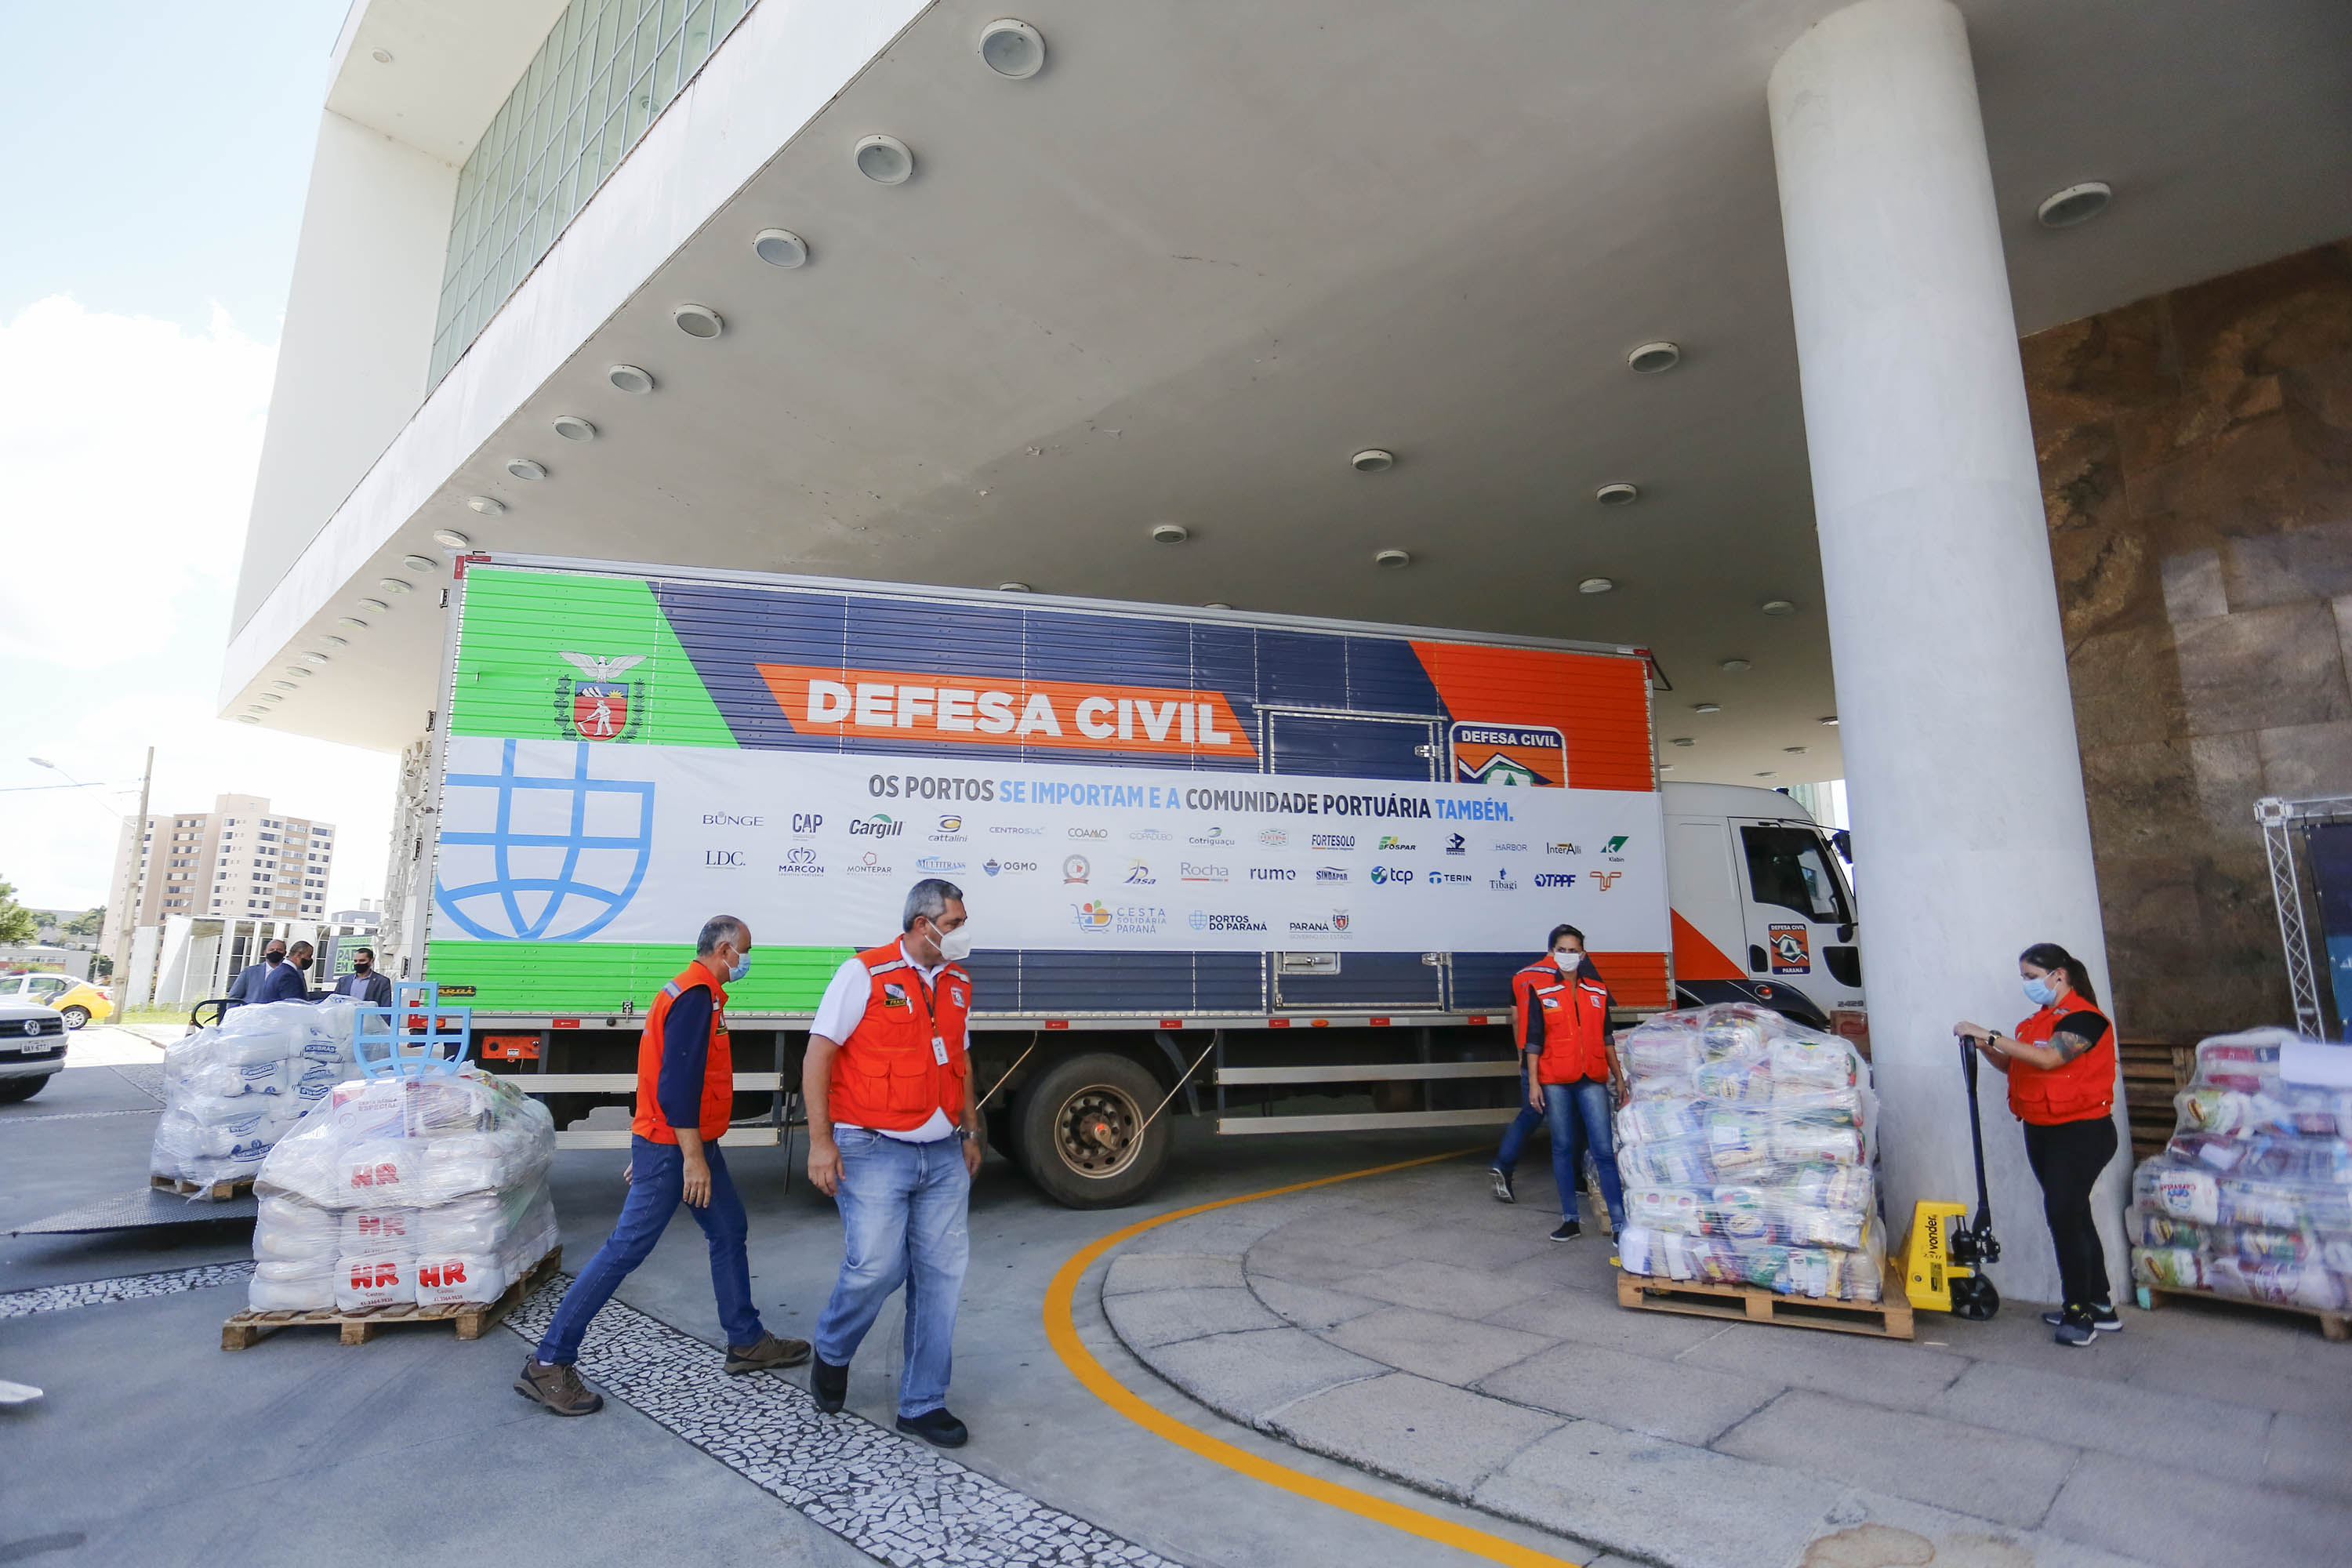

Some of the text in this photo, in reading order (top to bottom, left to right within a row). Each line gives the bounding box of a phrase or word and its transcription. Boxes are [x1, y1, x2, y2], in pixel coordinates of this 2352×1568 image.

[807, 679, 1231, 744] DEFESA CIVIL
[1461, 730, 1559, 747] DEFESA CIVIL
[869, 774, 1514, 822] OS PORTOS SE IMPORTAM E A COMUNIDADE PORTUÁRIA TAMBÉM.
[702, 814, 765, 826] BUNGE
[793, 813, 823, 833] CAP
[849, 819, 903, 839] Cargill
[1068, 828, 1108, 839] COAMO
[927, 834, 967, 843] cattalini
[1189, 837, 1235, 846] Cotriguaçu
[1312, 834, 1356, 847] FORTESOLO
[1004, 862, 1037, 871] OGMO
[1180, 862, 1229, 877] Rocha
[1250, 868, 1296, 880] rumo
[1316, 870, 1348, 880] SINDAPAR
[1391, 867, 1414, 884] tcp
[1490, 880, 1518, 891] Tibagi
[1116, 907, 1166, 916] CESTA
[1227, 921, 1268, 931] PARANÁ
[1290, 920, 1330, 931] PARANÁ
[351, 1163, 400, 1189] HR
[358, 1214, 405, 1236] HR
[1925, 1215, 1938, 1250] vonder
[351, 1262, 399, 1290] HR
[419, 1258, 467, 1287] HR
